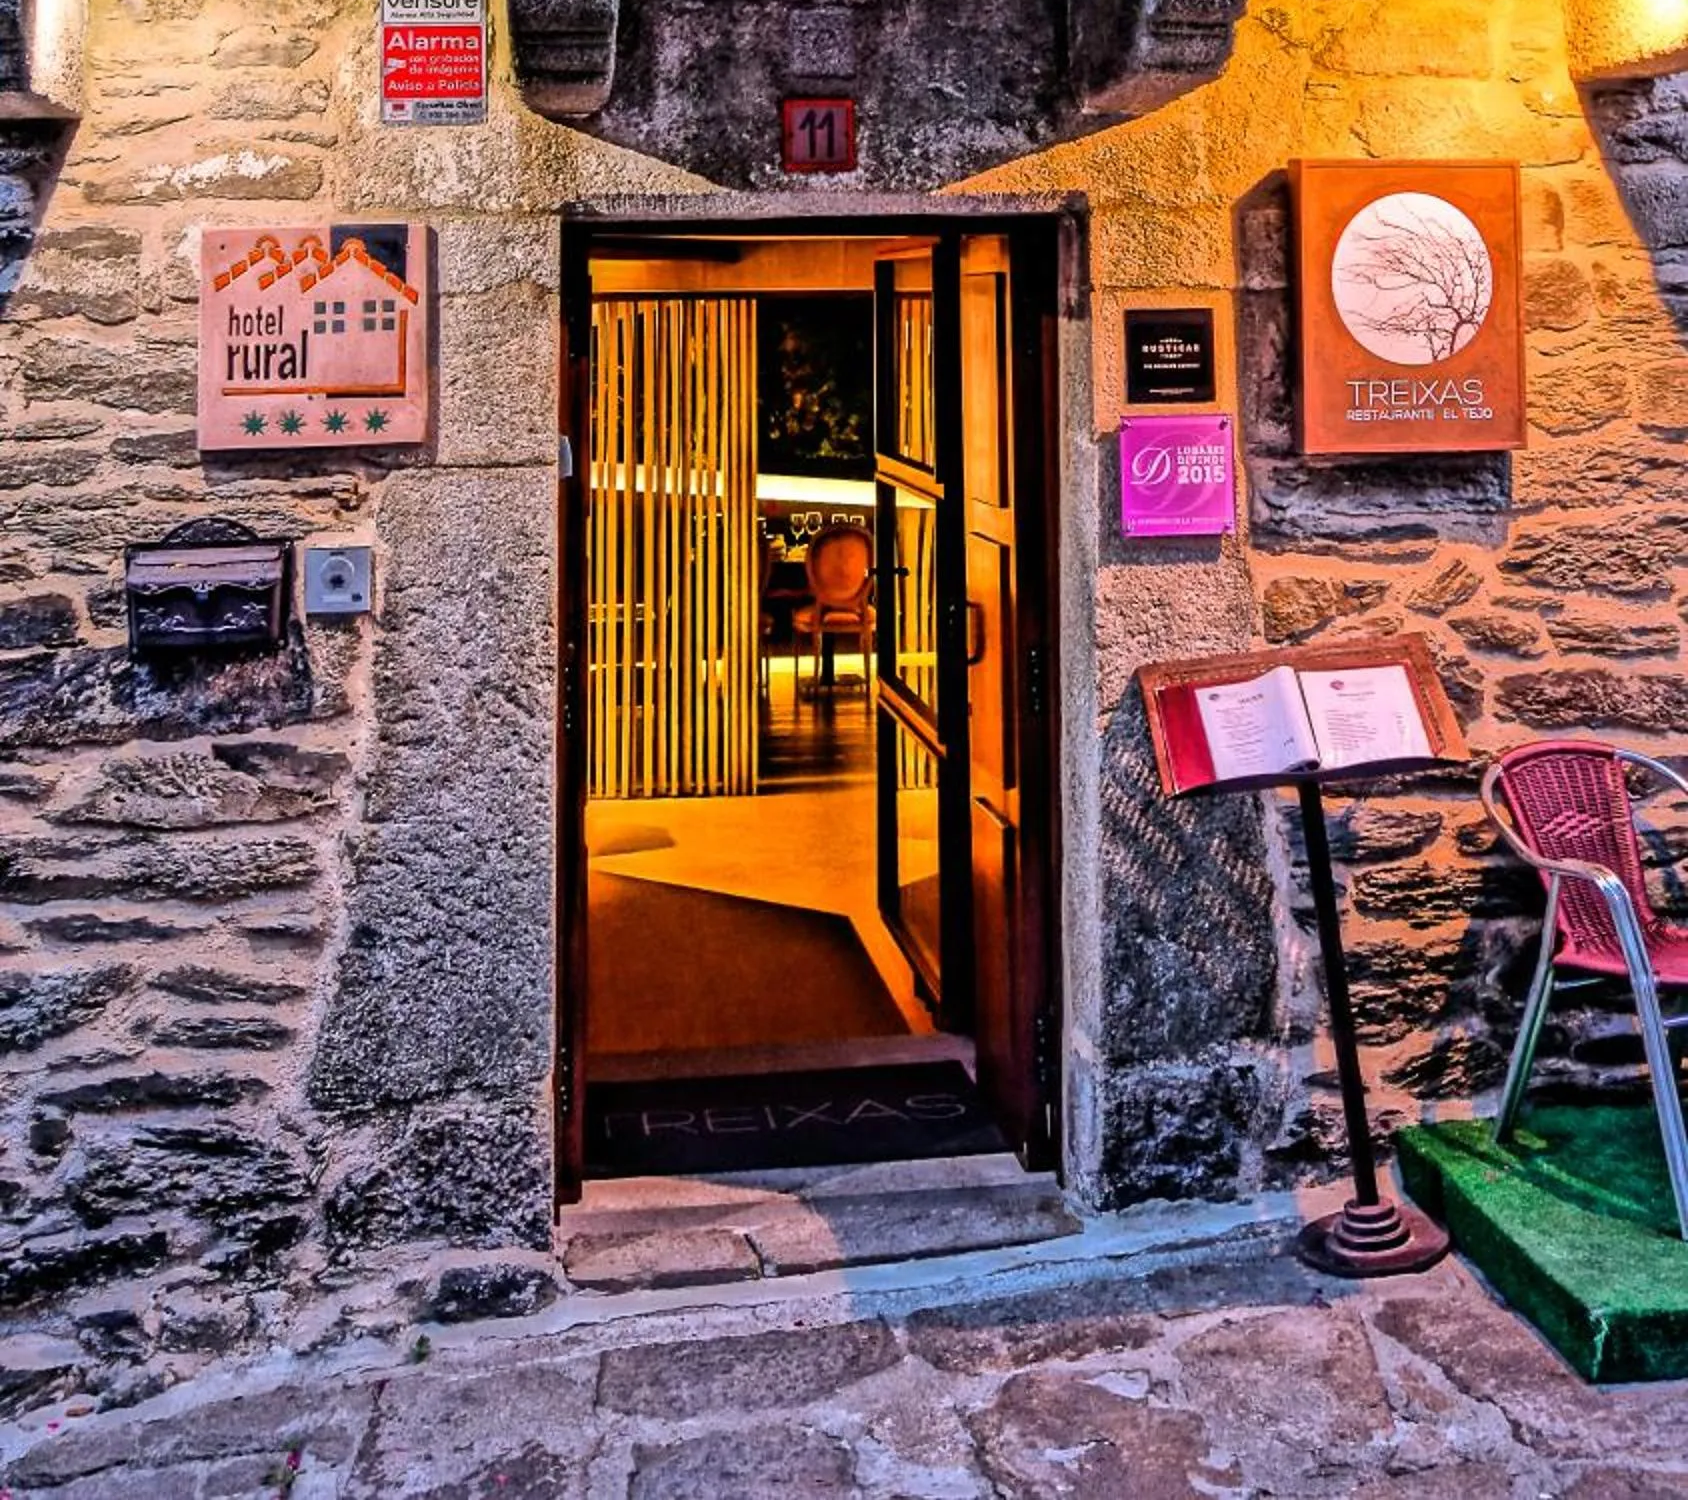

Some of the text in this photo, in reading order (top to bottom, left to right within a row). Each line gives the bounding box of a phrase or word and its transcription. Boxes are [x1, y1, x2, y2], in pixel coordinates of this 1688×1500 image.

[387, 30, 479, 50] Alarma
[409, 55, 427, 63] con
[409, 64, 423, 75] de
[387, 80, 424, 92] Aviso
[799, 109, 835, 159] 11
[228, 304, 284, 337] hotel
[226, 329, 308, 381] rural
[1346, 379, 1484, 406] TREIXAS
[1346, 409, 1435, 421] RESTAURANTE
[1443, 408, 1458, 420] EL
[1177, 465, 1226, 485] 2015
